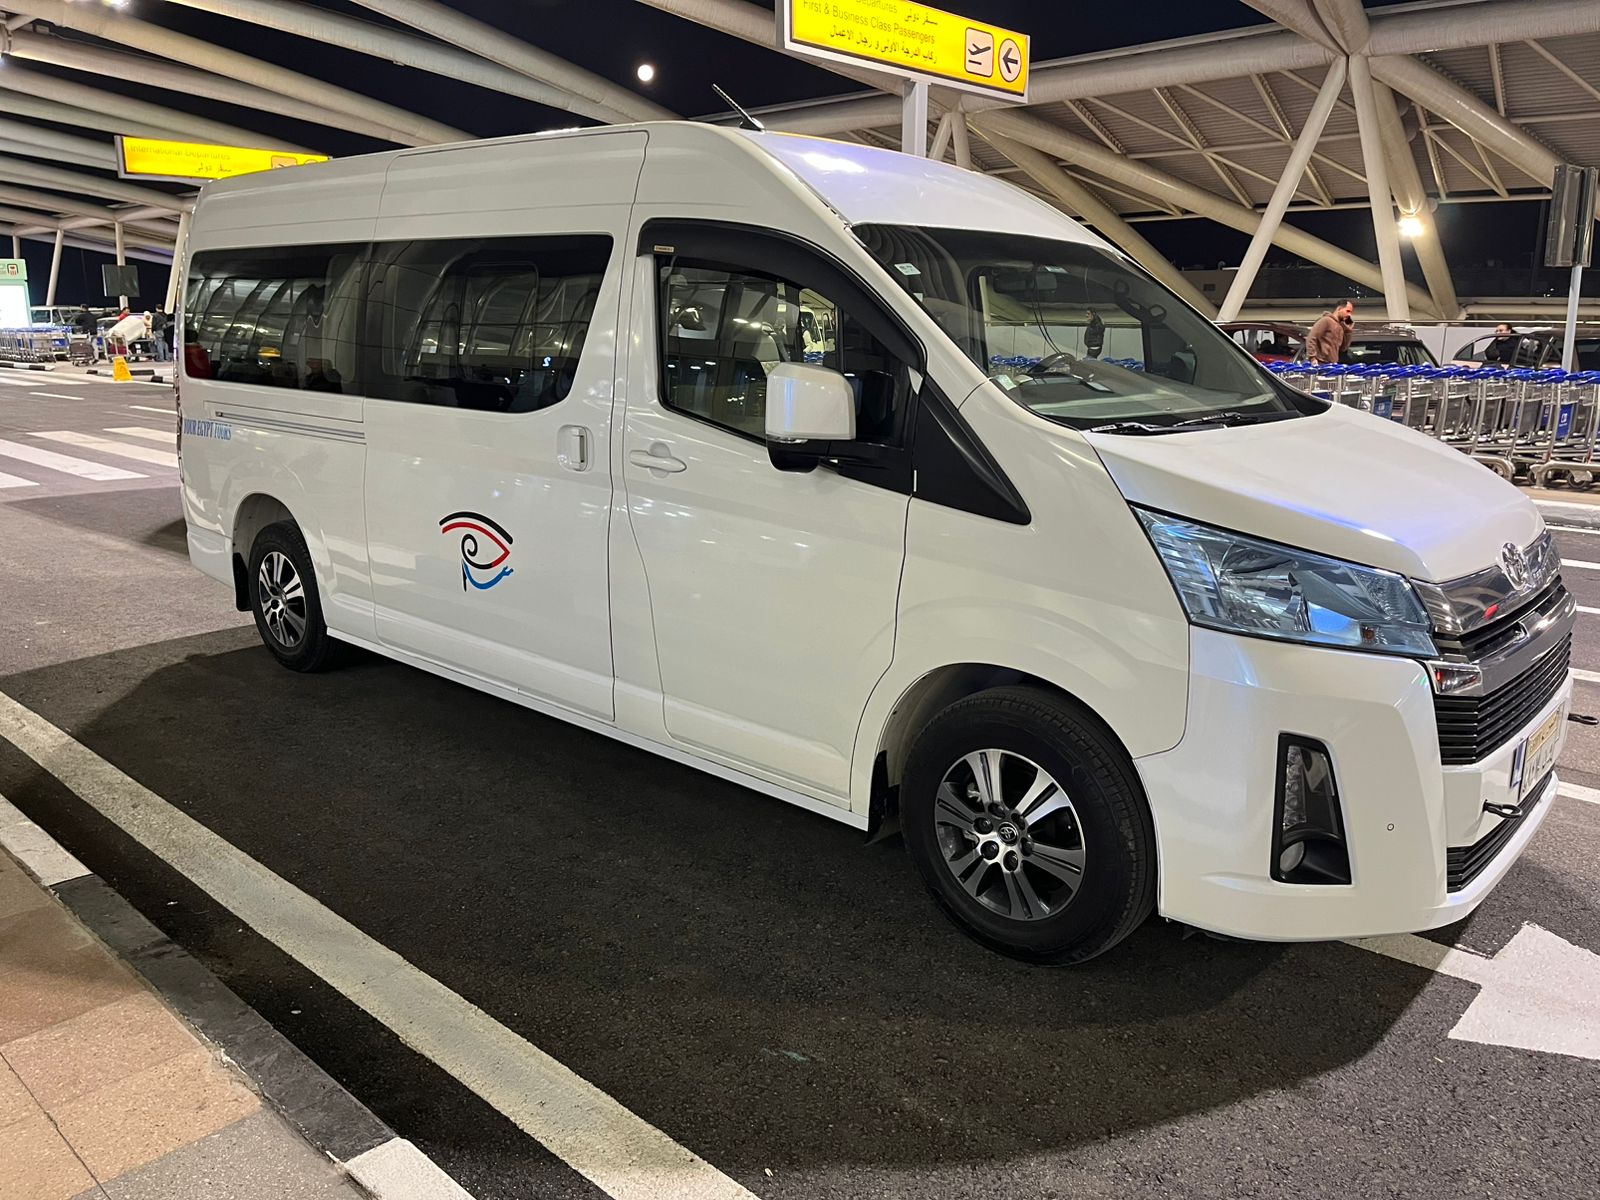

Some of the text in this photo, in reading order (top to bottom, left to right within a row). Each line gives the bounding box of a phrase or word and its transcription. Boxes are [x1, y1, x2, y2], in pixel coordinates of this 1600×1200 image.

[823, 2, 829, 15] &
[832, 5, 868, 26] Business
[870, 16, 891, 33] Class
[893, 22, 935, 44] Passengers
[197, 420, 214, 438] EGYPT
